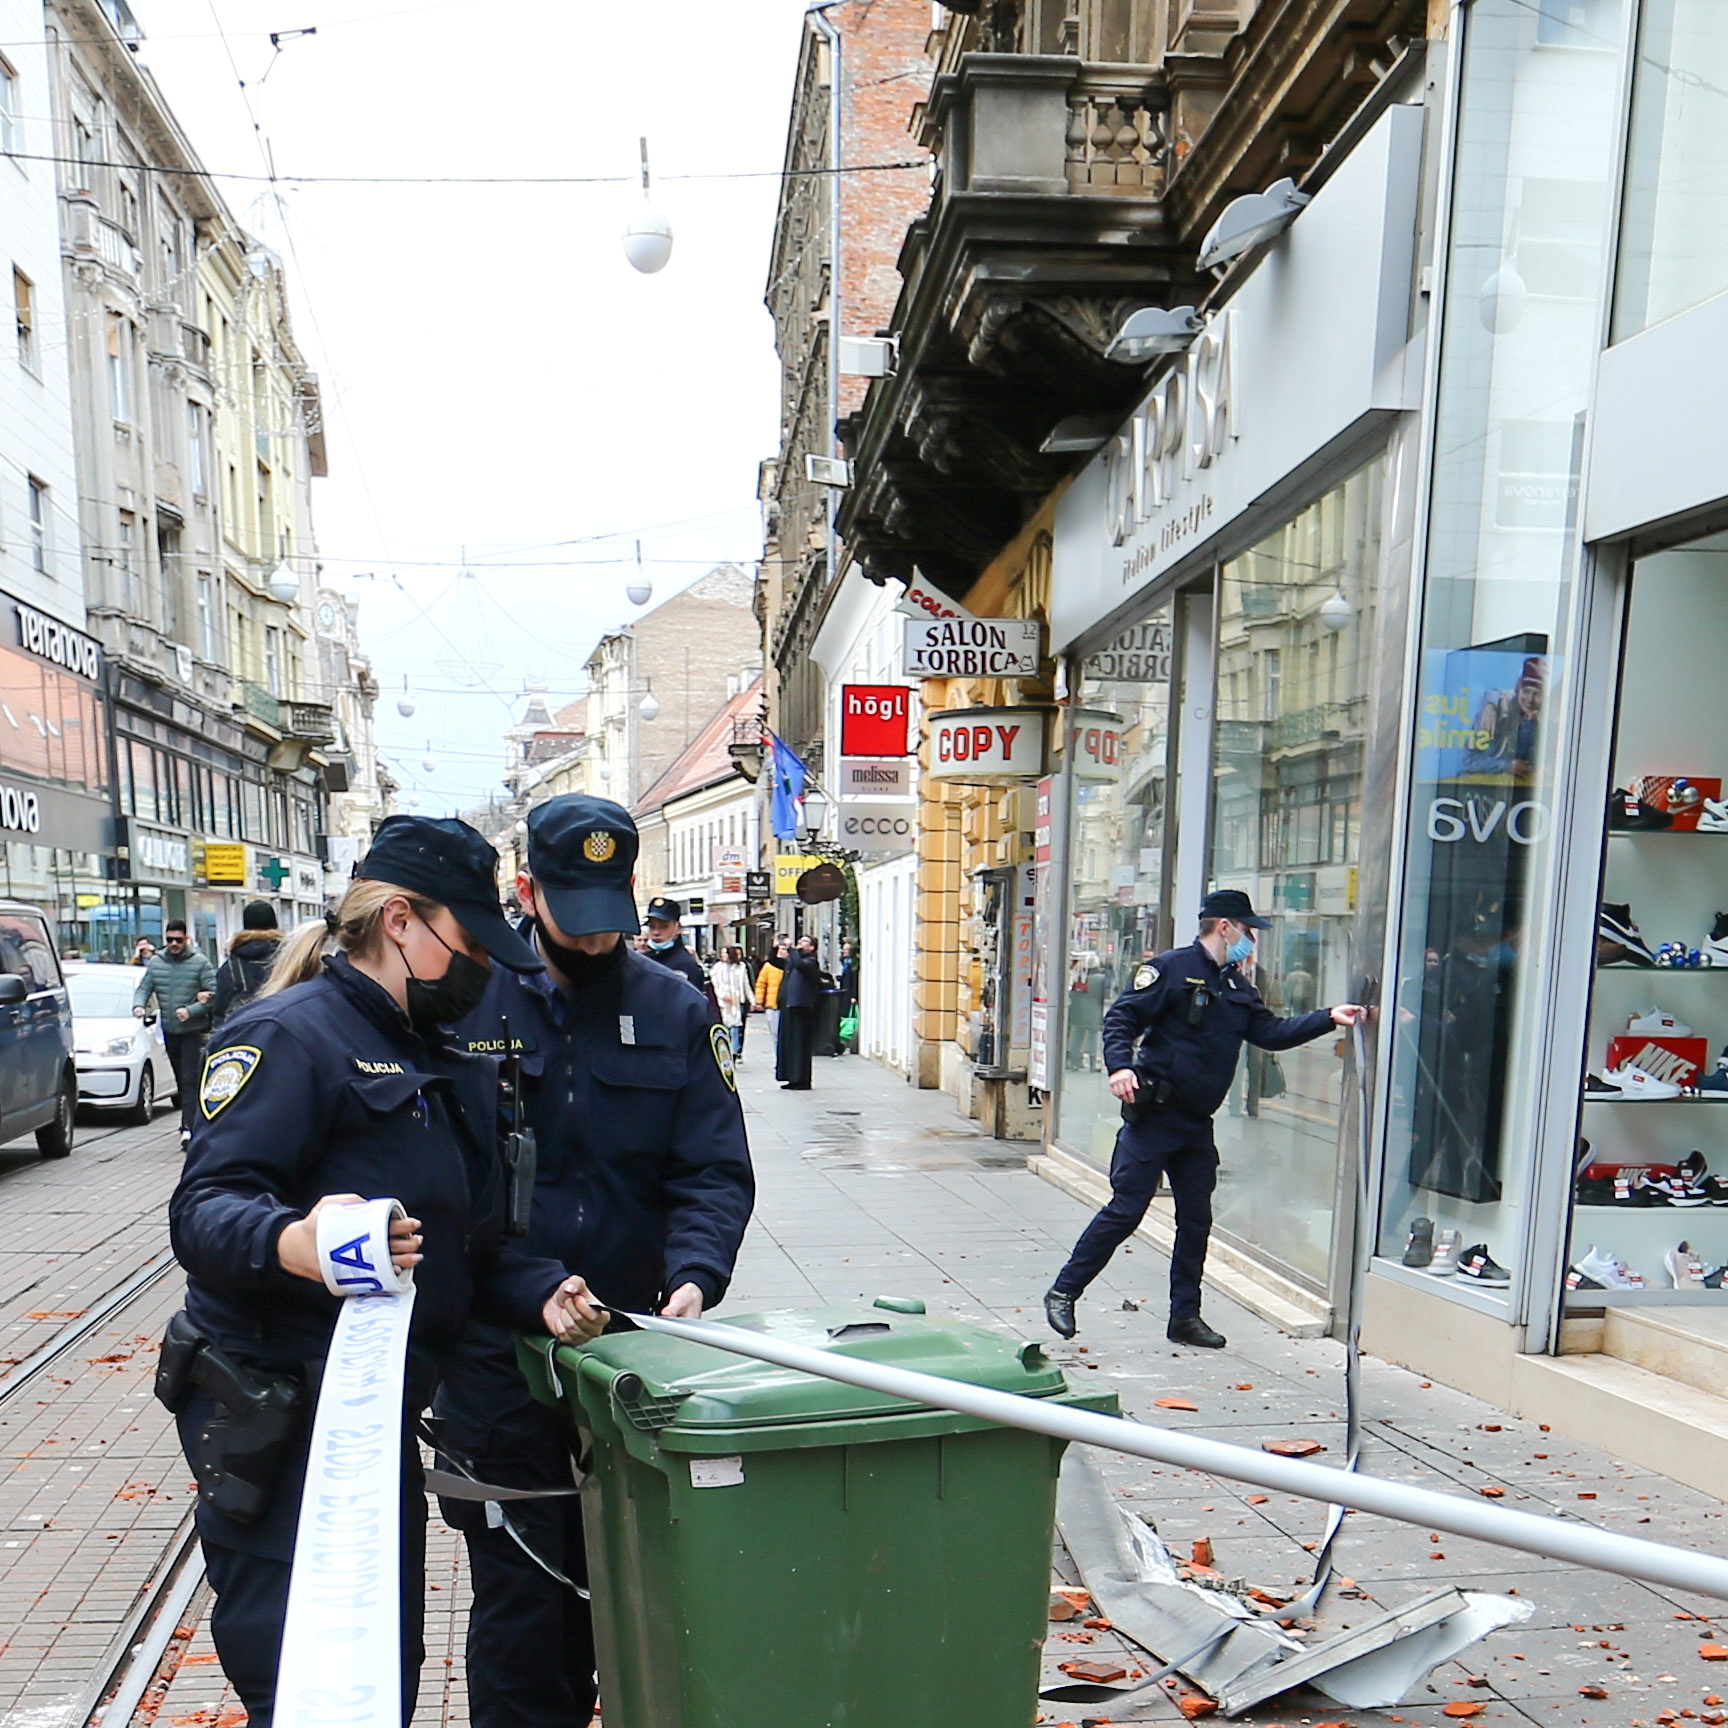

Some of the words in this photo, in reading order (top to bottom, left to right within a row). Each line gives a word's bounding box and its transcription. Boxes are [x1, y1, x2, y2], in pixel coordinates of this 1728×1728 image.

[1122, 541, 1156, 585] italian
[1161, 493, 1213, 552] lifestyle
[926, 620, 1006, 649] SALON
[913, 649, 1019, 675] TORBICA
[939, 725, 1021, 762] COPY
[852, 765, 899, 784] melissa
[845, 817, 909, 835] ecco
[722, 850, 740, 861] dm
[468, 1039, 524, 1052] POLICJA
[1630, 1042, 1697, 1087] NIKE
